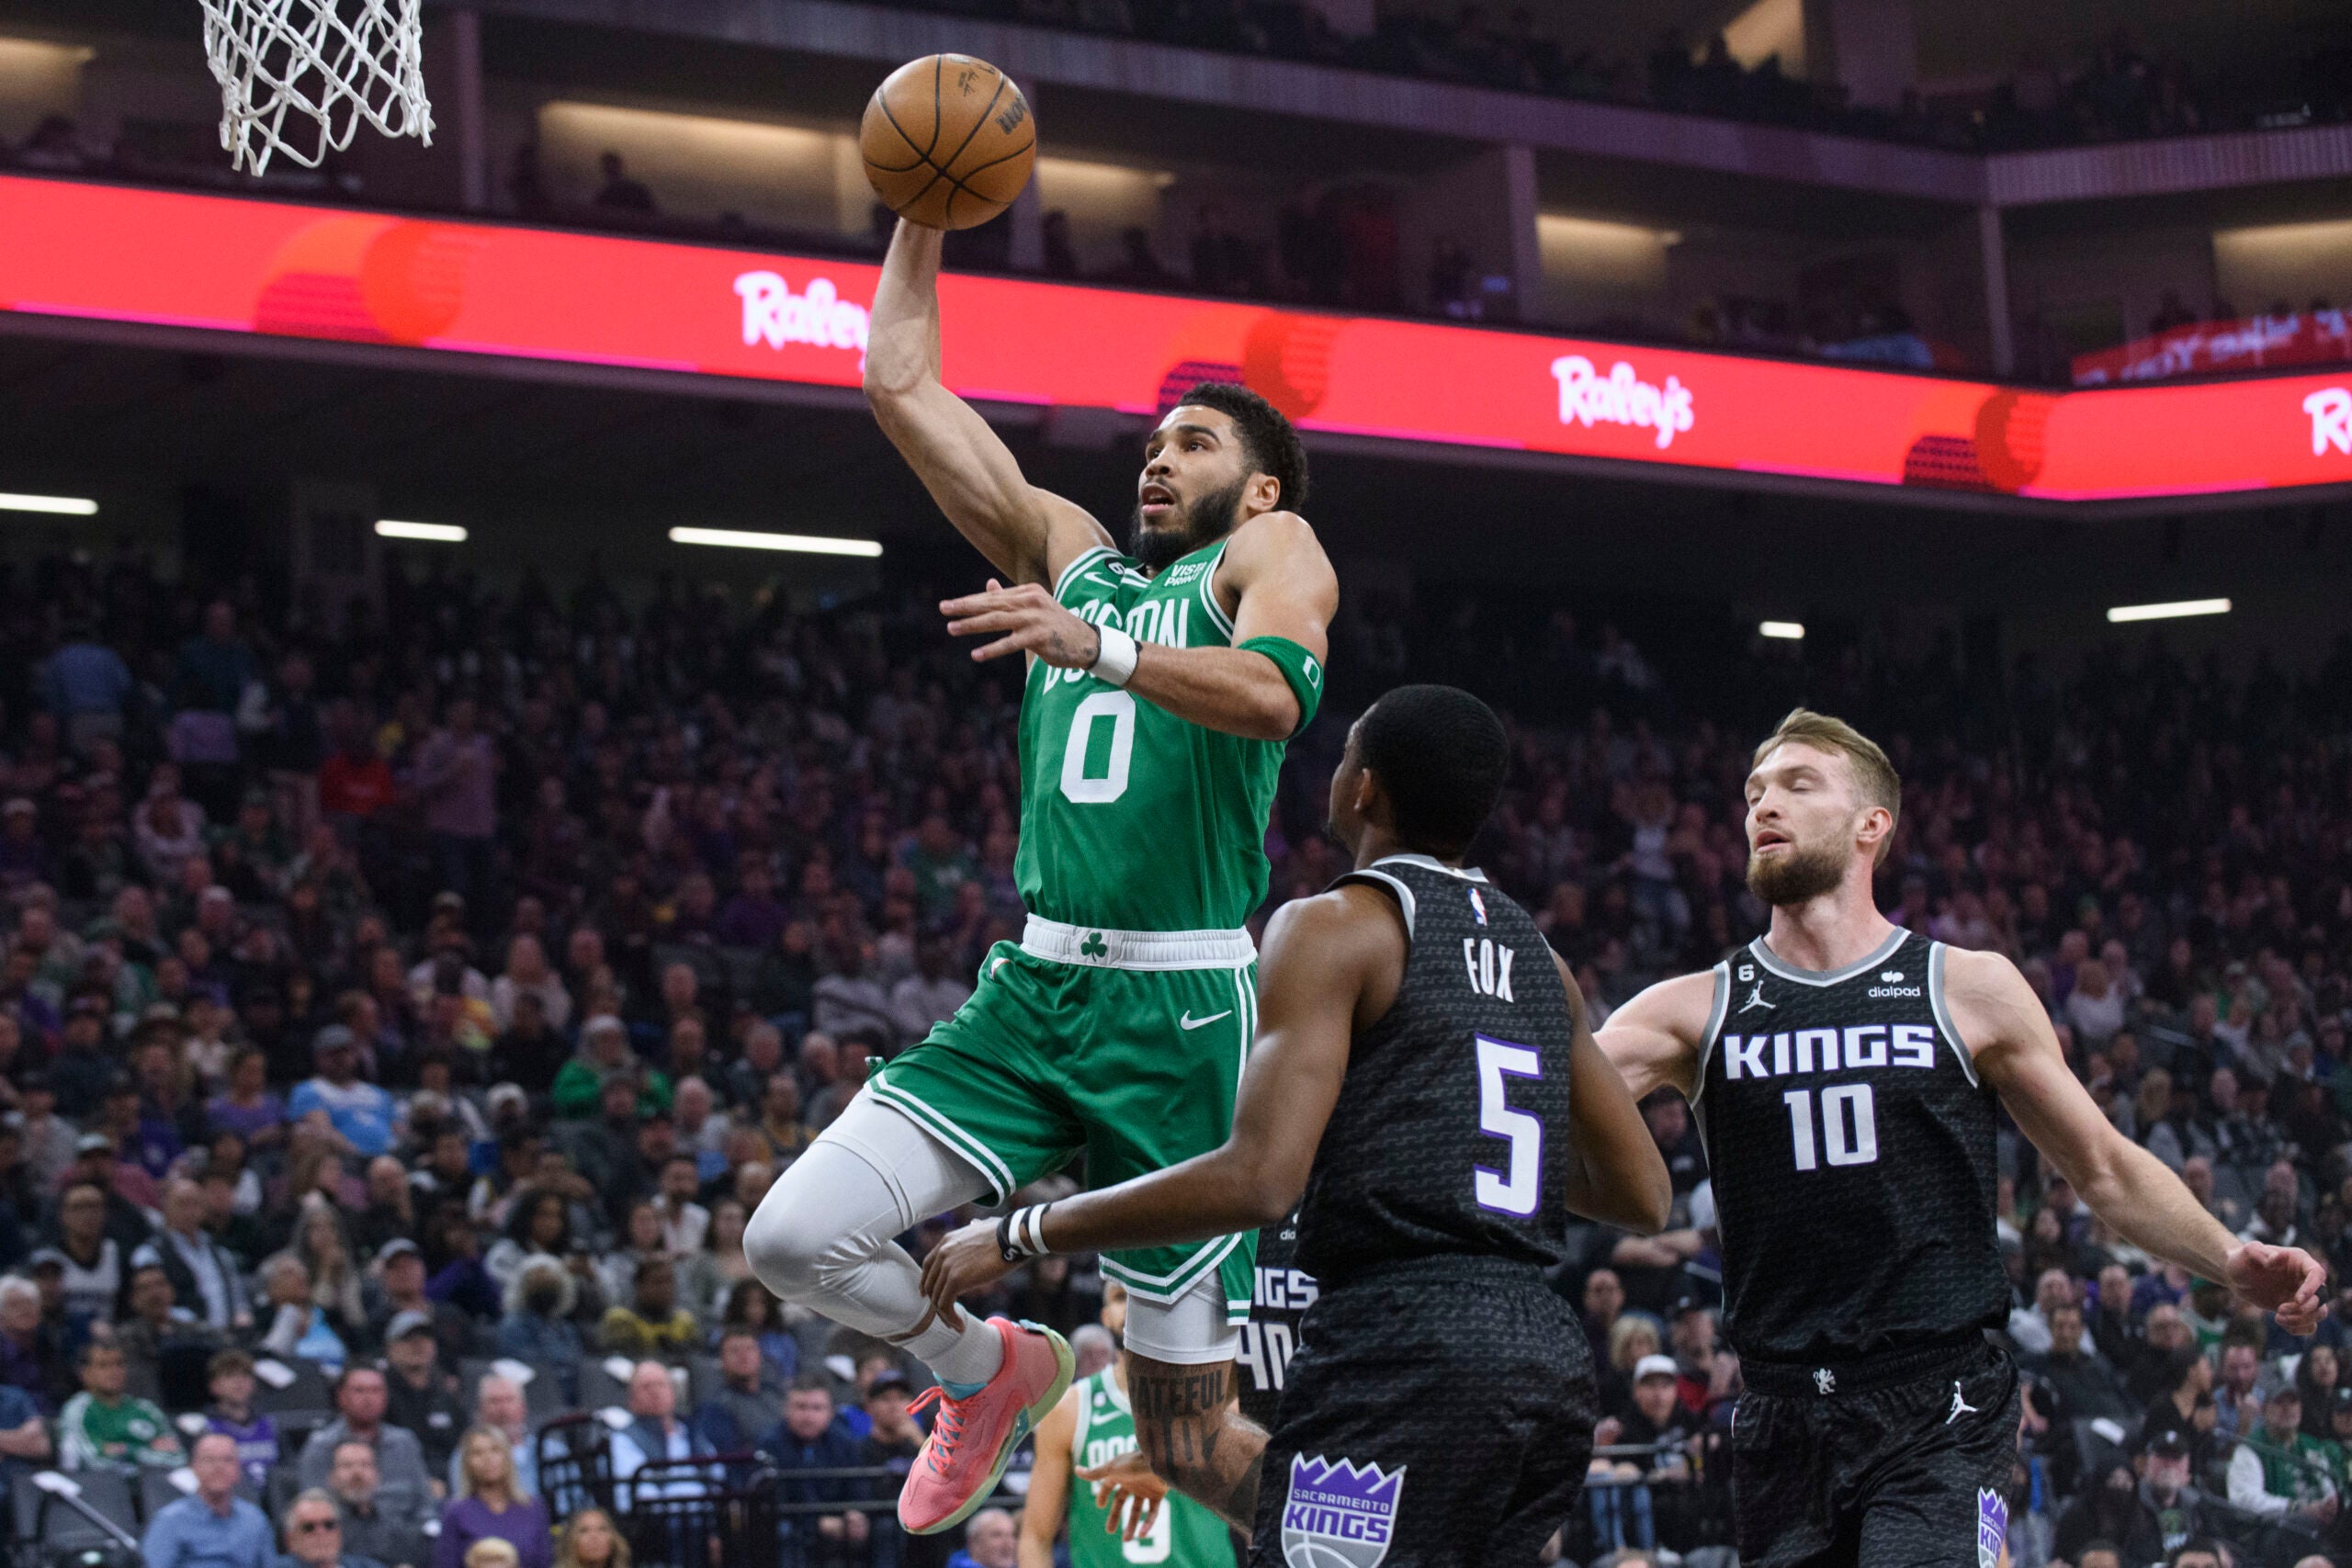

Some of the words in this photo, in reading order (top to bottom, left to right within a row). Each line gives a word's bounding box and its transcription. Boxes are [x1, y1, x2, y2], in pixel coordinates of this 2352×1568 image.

[1551, 355, 1694, 449] Raley's
[1108, 561, 1125, 576] 6
[1171, 561, 1207, 577] VISTA
[1059, 690, 1136, 803] 0
[1463, 937, 1514, 1003] FOX
[1738, 964, 1755, 981] 6
[1868, 985, 1921, 998] dialpad
[1724, 1024, 1935, 1080] KINGS
[1474, 1031, 1544, 1219] 5
[1782, 1082, 1879, 1172] 10
[1236, 1321, 1294, 1391] 40
[1284, 1503, 1389, 1544] KINGS
[1293, 1487, 1390, 1514] SACRAMENTO
